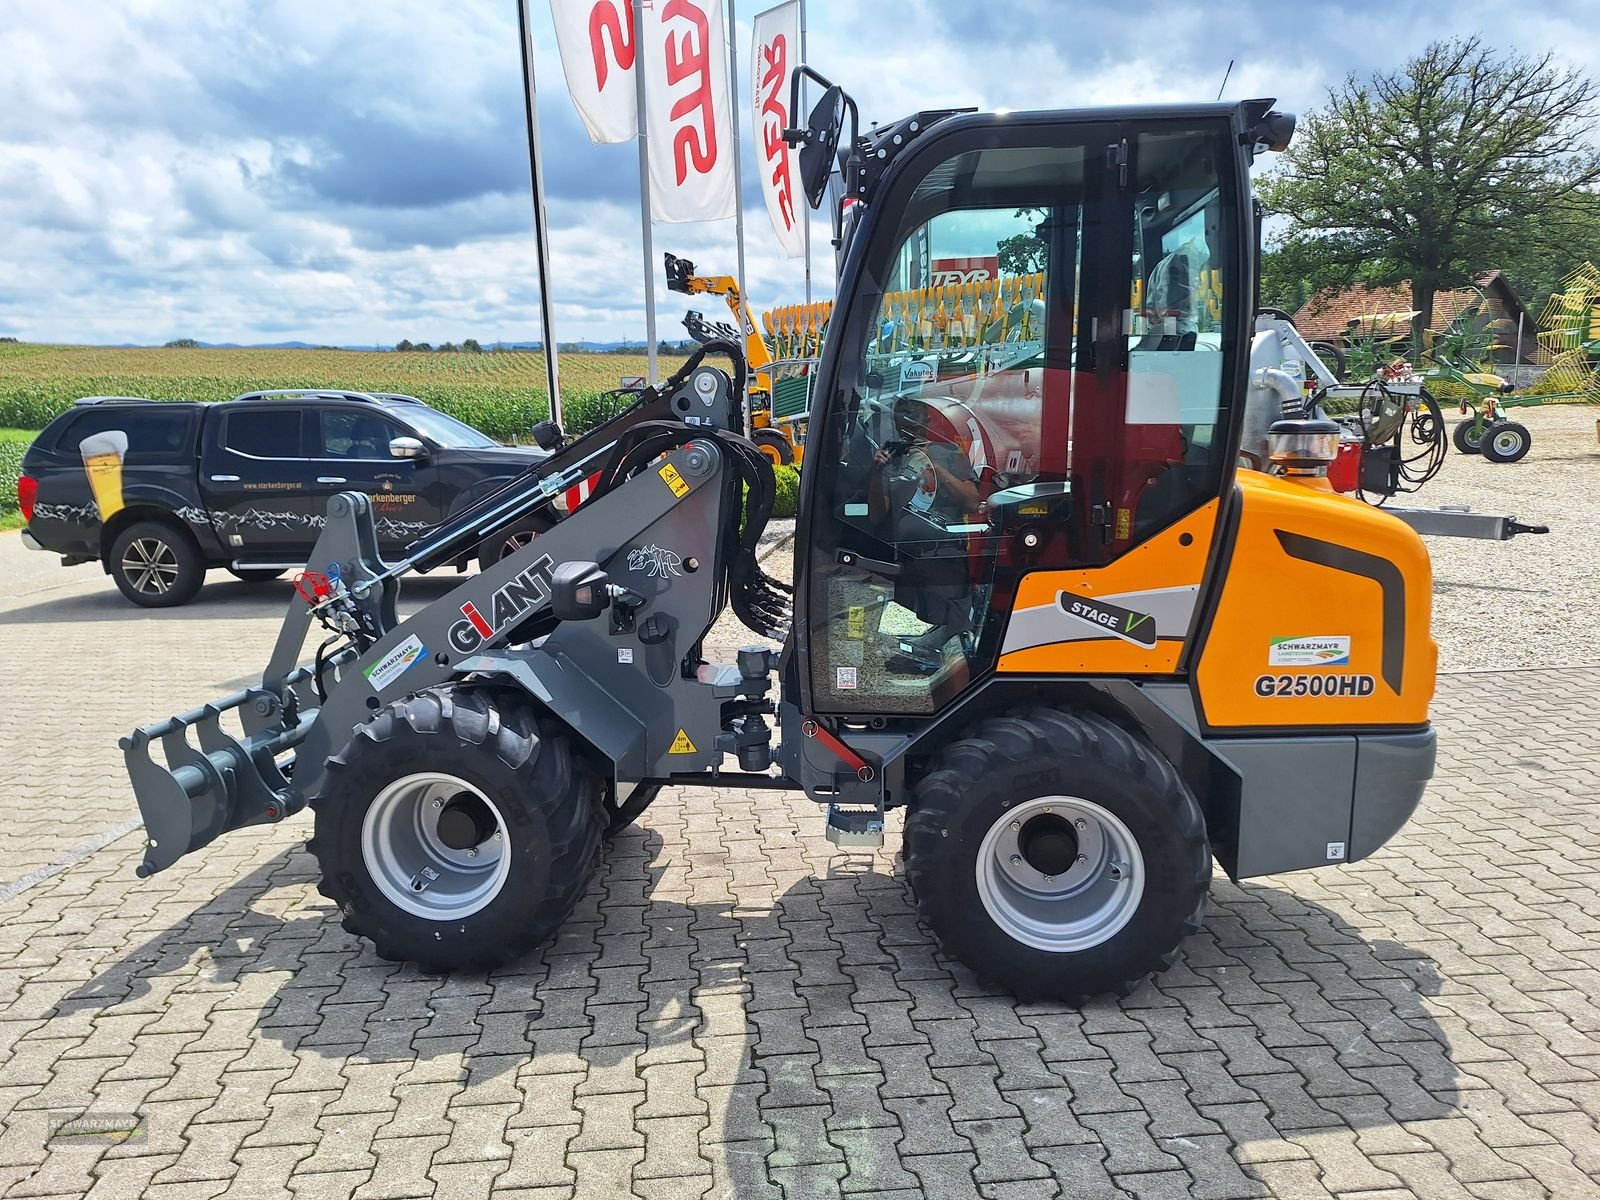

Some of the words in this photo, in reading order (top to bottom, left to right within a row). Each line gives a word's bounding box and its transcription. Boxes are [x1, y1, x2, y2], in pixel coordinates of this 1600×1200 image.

[930, 270, 990, 287] TEYR
[904, 367, 933, 379] Vakutec
[369, 493, 417, 505] arkenberger
[1071, 602, 1119, 628] STAGE
[1125, 612, 1153, 633] V
[371, 644, 413, 678] SCHWARZMAYR
[1254, 674, 1376, 697] G2500HD
